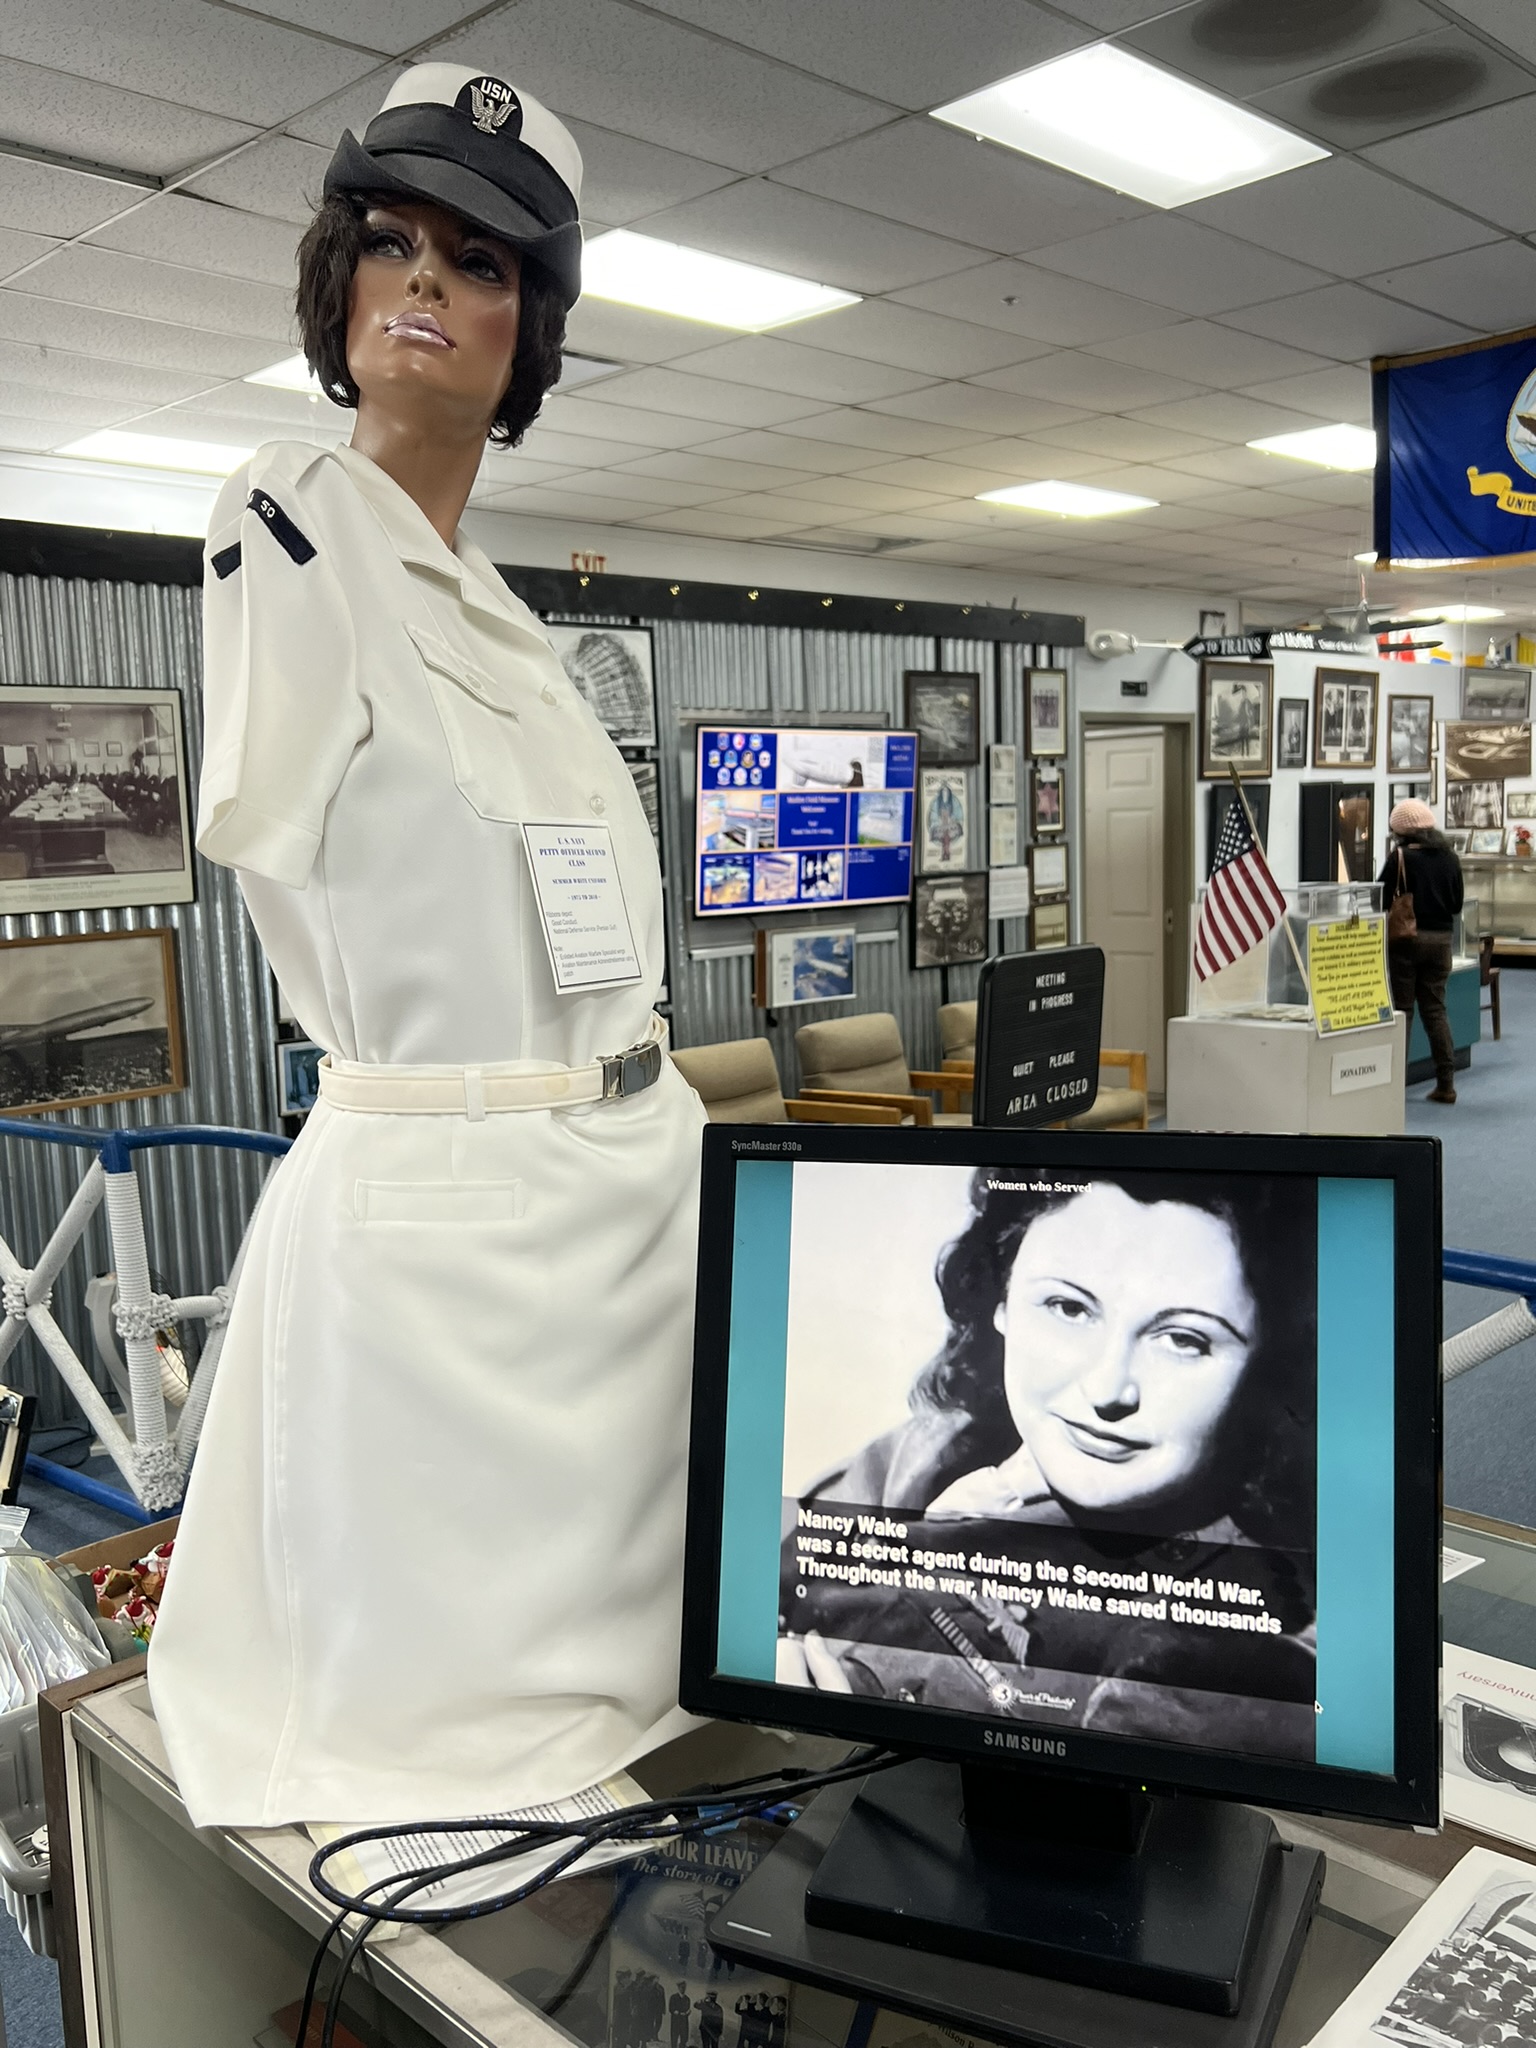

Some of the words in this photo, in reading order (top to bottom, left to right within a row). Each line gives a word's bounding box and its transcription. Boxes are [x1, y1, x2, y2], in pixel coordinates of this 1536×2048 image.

[480, 79, 512, 104] USN
[1205, 642, 1218, 654] TO
[1219, 637, 1262, 656] TRAINS
[539, 848, 560, 856] PETTY
[560, 848, 585, 856] OFFICER
[585, 848, 606, 856] SECOND
[568, 859, 586, 867] CLASS
[1036, 972, 1066, 988] MEETING
[1041, 992, 1074, 1010] PROGRESS
[1012, 1061, 1034, 1078] QUIET
[1049, 1051, 1075, 1069] PLEASE
[1339, 1064, 1377, 1080] DONATIONS
[1006, 1093, 1037, 1116] AREA
[1046, 1077, 1089, 1104] CLOSED
[731, 1139, 781, 1152] SyncMaster
[986, 1179, 1027, 1192] Women
[1029, 1180, 1053, 1192] who
[1054, 1181, 1093, 1193] Served
[797, 1508, 854, 1537] Nancy
[857, 1514, 909, 1540] Wake
[796, 1535, 833, 1555] was
[835, 1540, 848, 1556] a
[850, 1541, 909, 1564] secret
[912, 1548, 966, 1571] agent
[969, 1551, 1032, 1583] during
[1035, 1559, 1069, 1583] the
[1072, 1563, 1149, 1593] Second
[1152, 1572, 1214, 1601] World
[1217, 1580, 1266, 1607] War.
[796, 1555, 902, 1587] Throughout
[904, 1568, 937, 1592] the
[938, 1576, 978, 1599] war,
[981, 1577, 1044, 1609] Nancy
[1047, 1585, 1103, 1613] Wake
[1105, 1596, 1167, 1621] saved
[1170, 1600, 1283, 1635] thousands
[983, 1729, 1067, 1757] SAMSUNG
[655, 1840, 699, 1864] OUR
[632, 1856, 659, 1874] The
[663, 1864, 702, 1884] story
[704, 1871, 721, 1887] of
[723, 1877, 734, 1888] a
